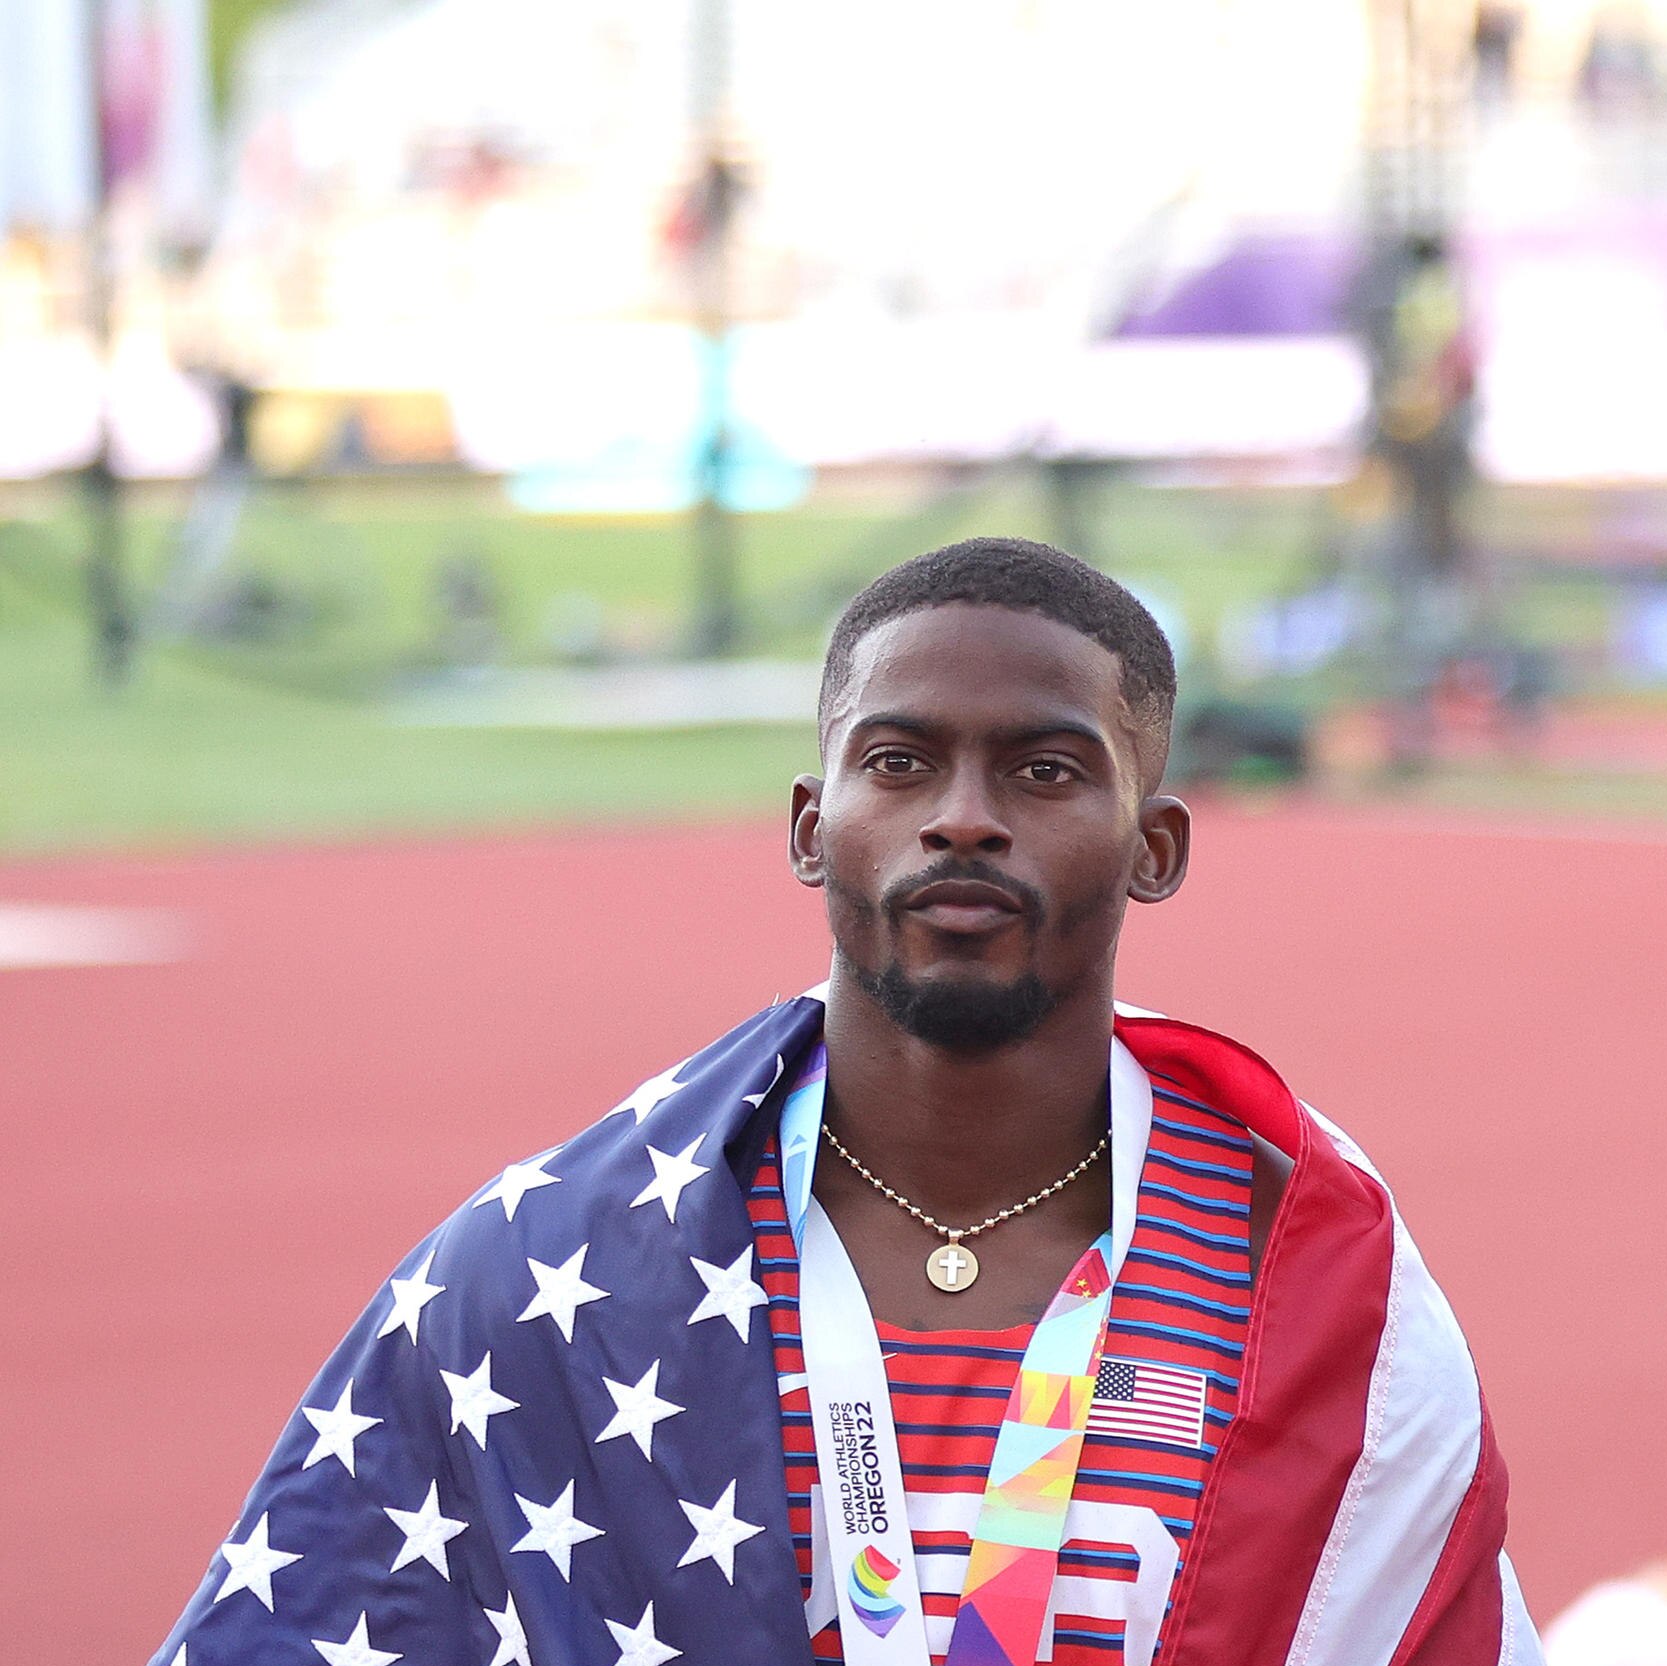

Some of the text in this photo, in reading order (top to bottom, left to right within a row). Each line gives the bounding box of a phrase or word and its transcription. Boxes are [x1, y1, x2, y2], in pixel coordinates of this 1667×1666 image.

[829, 1403, 856, 1534] WORLD ATHLETICS
[841, 1403, 869, 1534] CHAMPIONSHIPS
